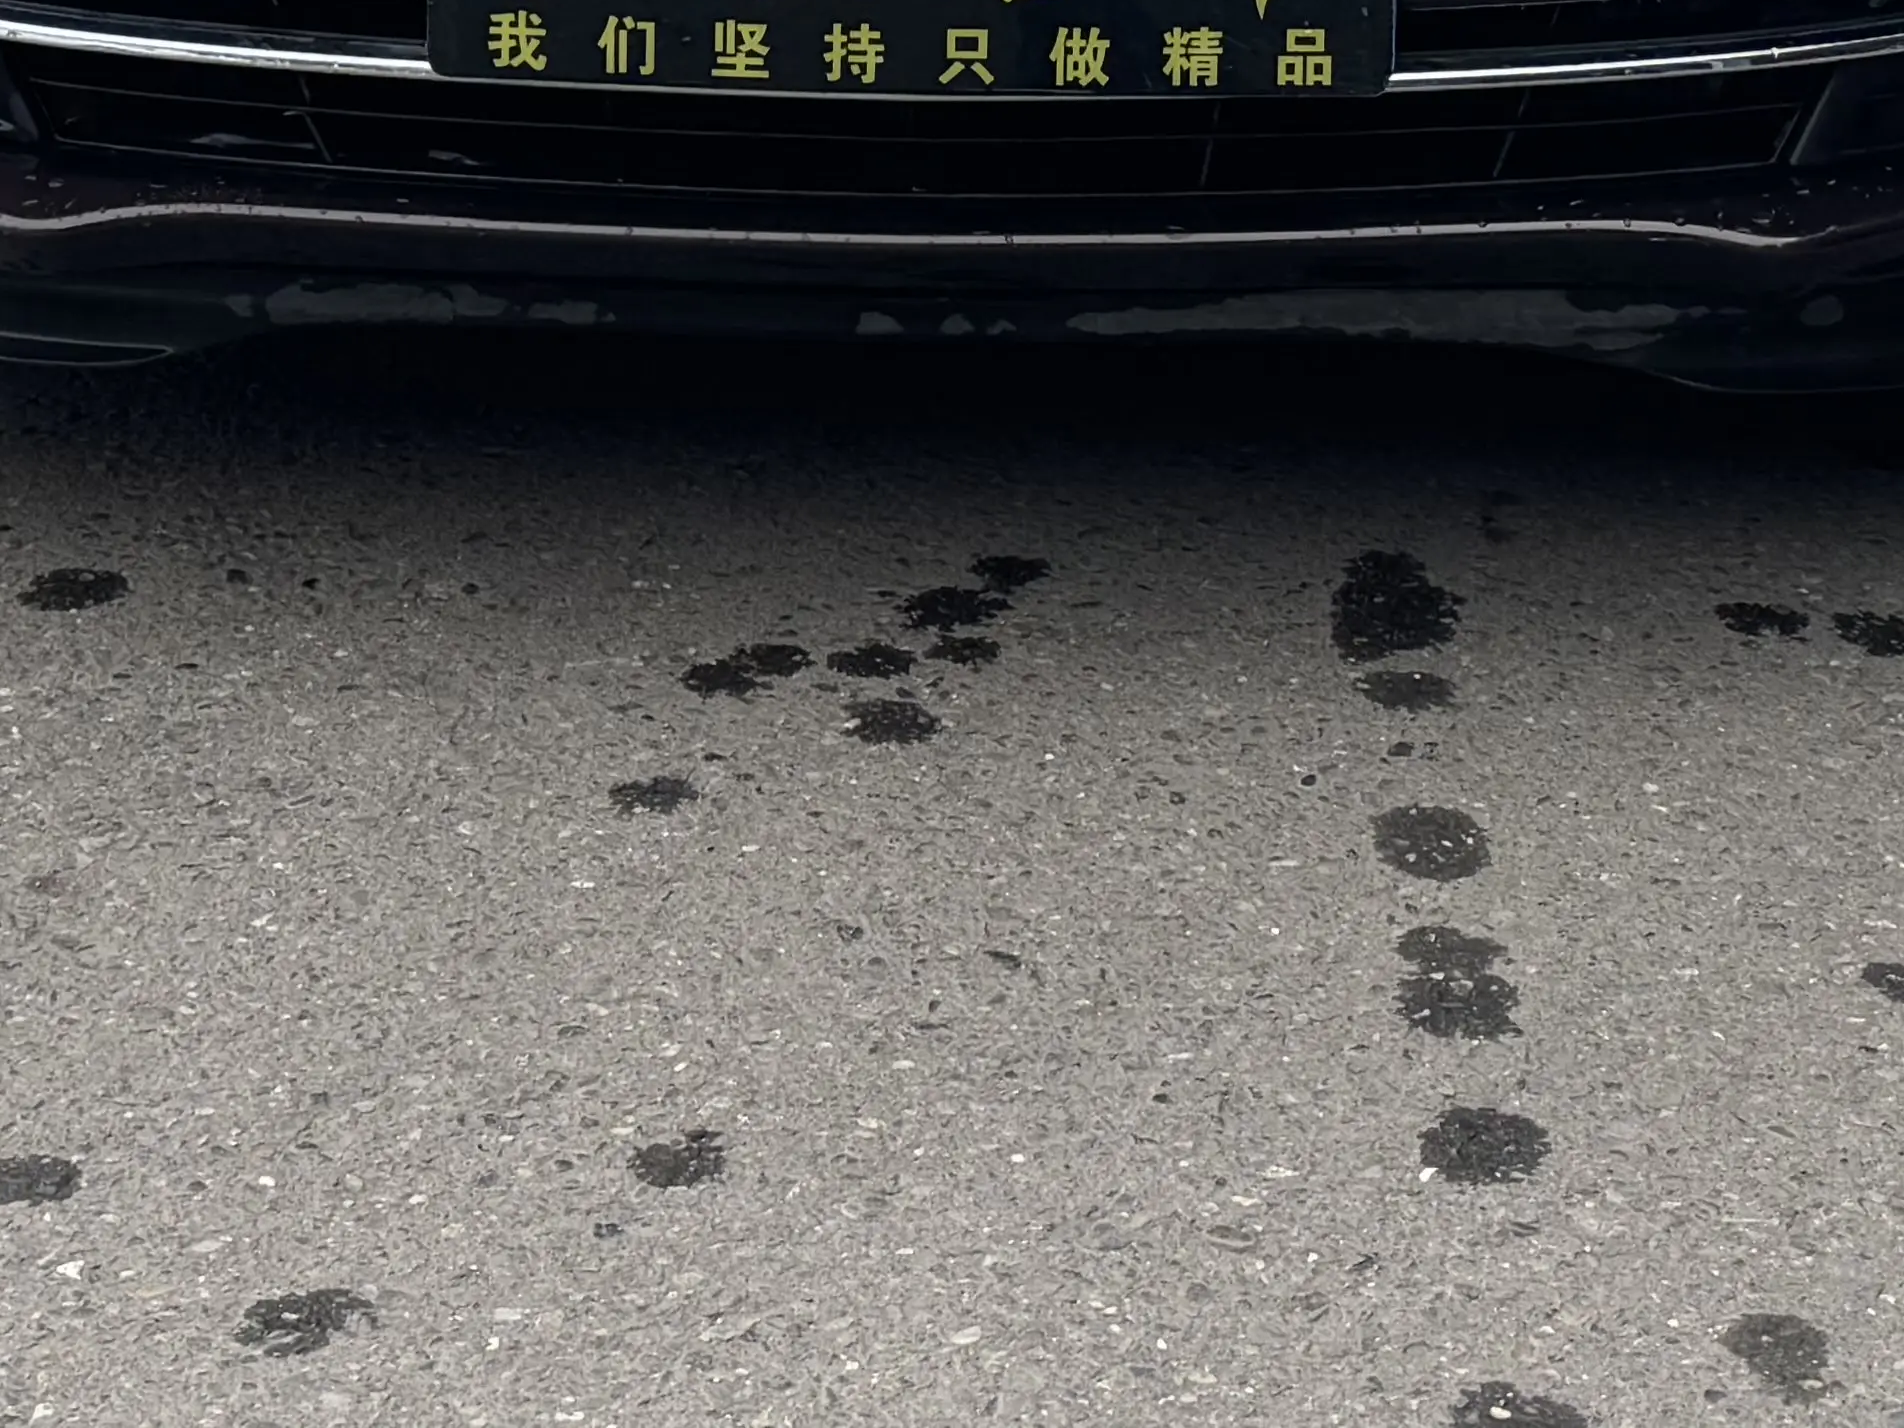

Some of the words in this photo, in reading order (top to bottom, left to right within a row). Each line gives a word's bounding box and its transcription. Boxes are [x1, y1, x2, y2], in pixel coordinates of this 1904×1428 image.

[487, 10, 1336, 89] 我们坚持只做精品
